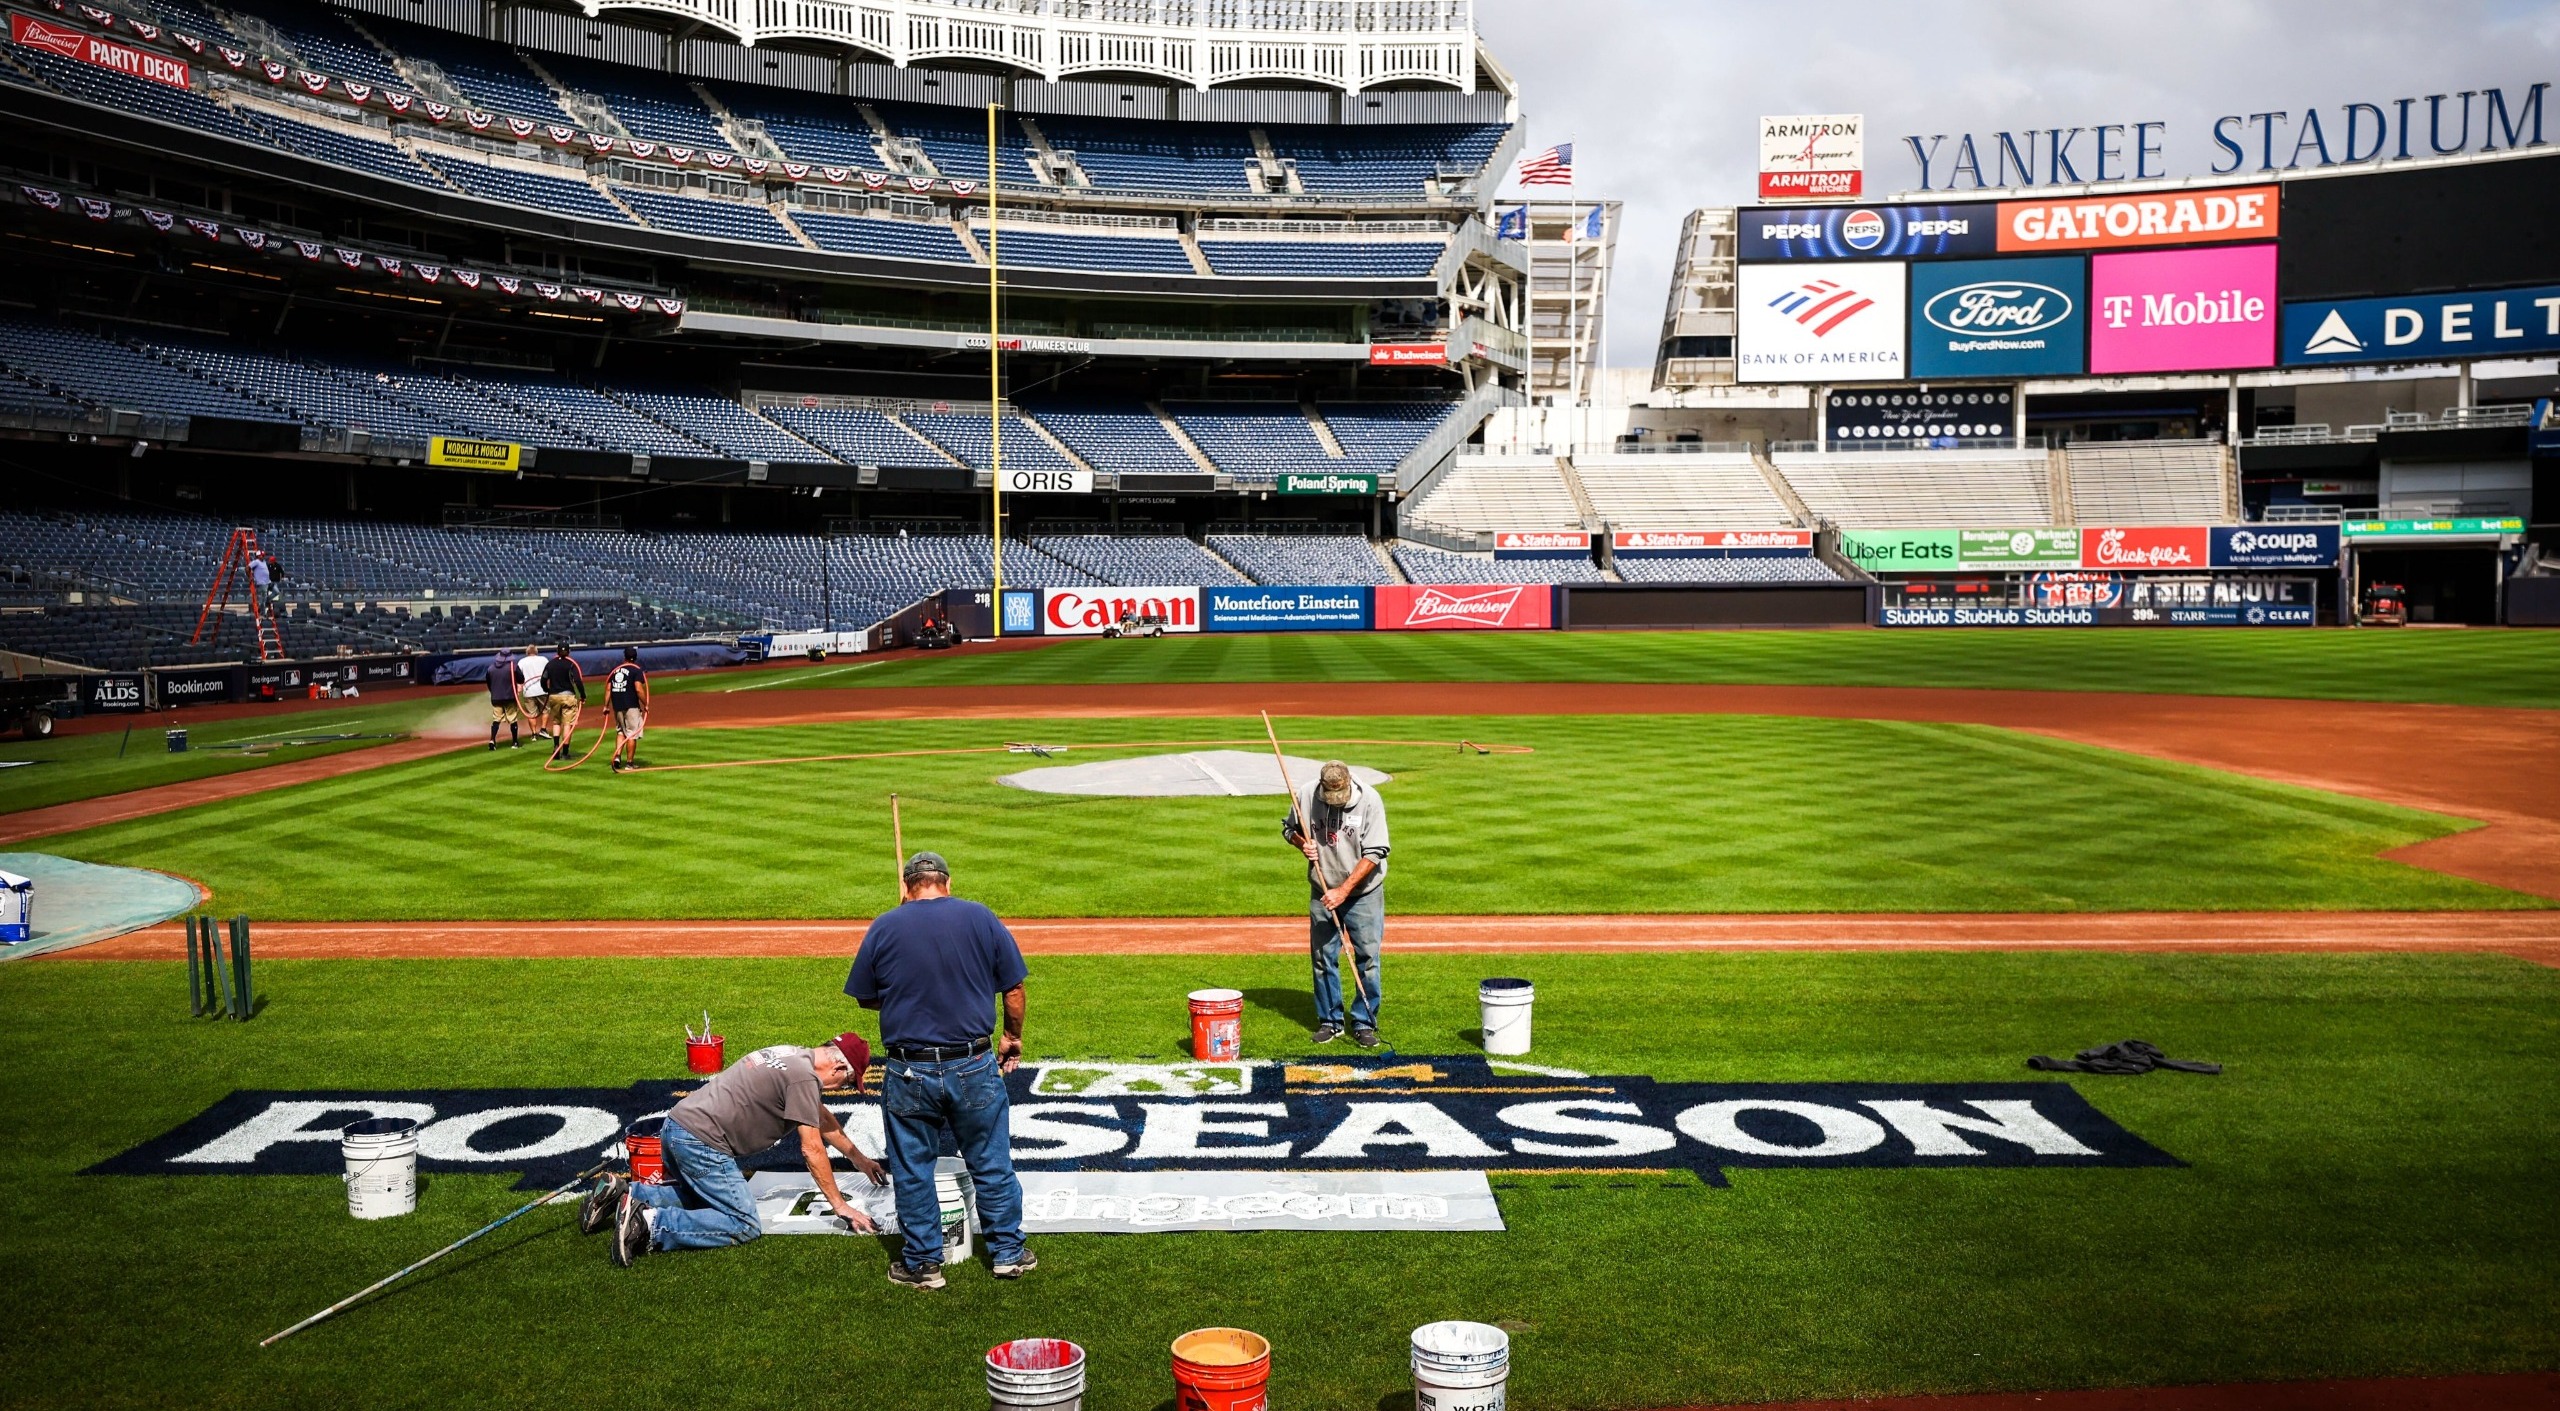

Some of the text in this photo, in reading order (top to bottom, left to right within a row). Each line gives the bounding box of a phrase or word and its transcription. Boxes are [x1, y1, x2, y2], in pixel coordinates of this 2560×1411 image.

[26, 25, 79, 50] Budweiser
[90, 41, 184, 86] PARTY DECK
[1765, 123, 1857, 137] ARMITRON
[1902, 81, 2554, 191] YANKEE STADIUM
[1769, 173, 1853, 187] ARMITRON
[1809, 185, 1851, 193] WATCHES
[2013, 194, 2265, 241] GATORADE
[1762, 224, 1821, 239] PEPSI
[1846, 225, 1881, 234] PEPSI
[1907, 219, 1968, 236] PEPSI
[1949, 288, 2047, 327] Ford
[2103, 289, 2265, 328] T Mobile
[1026, 340, 1065, 352] YANKEES
[1067, 342, 1090, 352] CLUB
[1948, 339, 2045, 353] BuyFordNow.com
[1393, 350, 1444, 360] Budweiser
[1742, 351, 1900, 364] BANK OF AMERICA
[446, 441, 507, 458] MORGAN & MORGAN
[1012, 471, 1073, 490] ORIS
[1287, 475, 1368, 493] Poland Spring
[2347, 522, 2386, 532] bet365
[2413, 521, 2452, 531] bet365
[2481, 519, 2523, 530] bet365
[2257, 532, 2318, 552] coupa
[1846, 541, 1953, 559] Uber Eats
[2229, 554, 2318, 565] Make Margins Multiply
[974, 592, 990, 604] 318
[1008, 596, 1029, 607] NEW
[1213, 594, 1360, 611] Montefiore Einstein
[1005, 606, 1032, 617] YORK
[1047, 592, 1195, 629] Canon
[1414, 596, 1511, 616] Budweiser
[1008, 616, 1030, 626] LIFE
[1316, 613, 1338, 621] Human
[1339, 613, 1360, 621] Health
[1886, 608, 2092, 625] StubHub StubHub StubHub
[2132, 608, 2153, 620] 399
[2171, 611, 2206, 621] STARR
[2269, 610, 2310, 620] CLEAR
[369, 666, 392, 675] Booking.com
[95, 687, 140, 700] ALDS
[166, 1098, 2106, 1164] POSEASON
